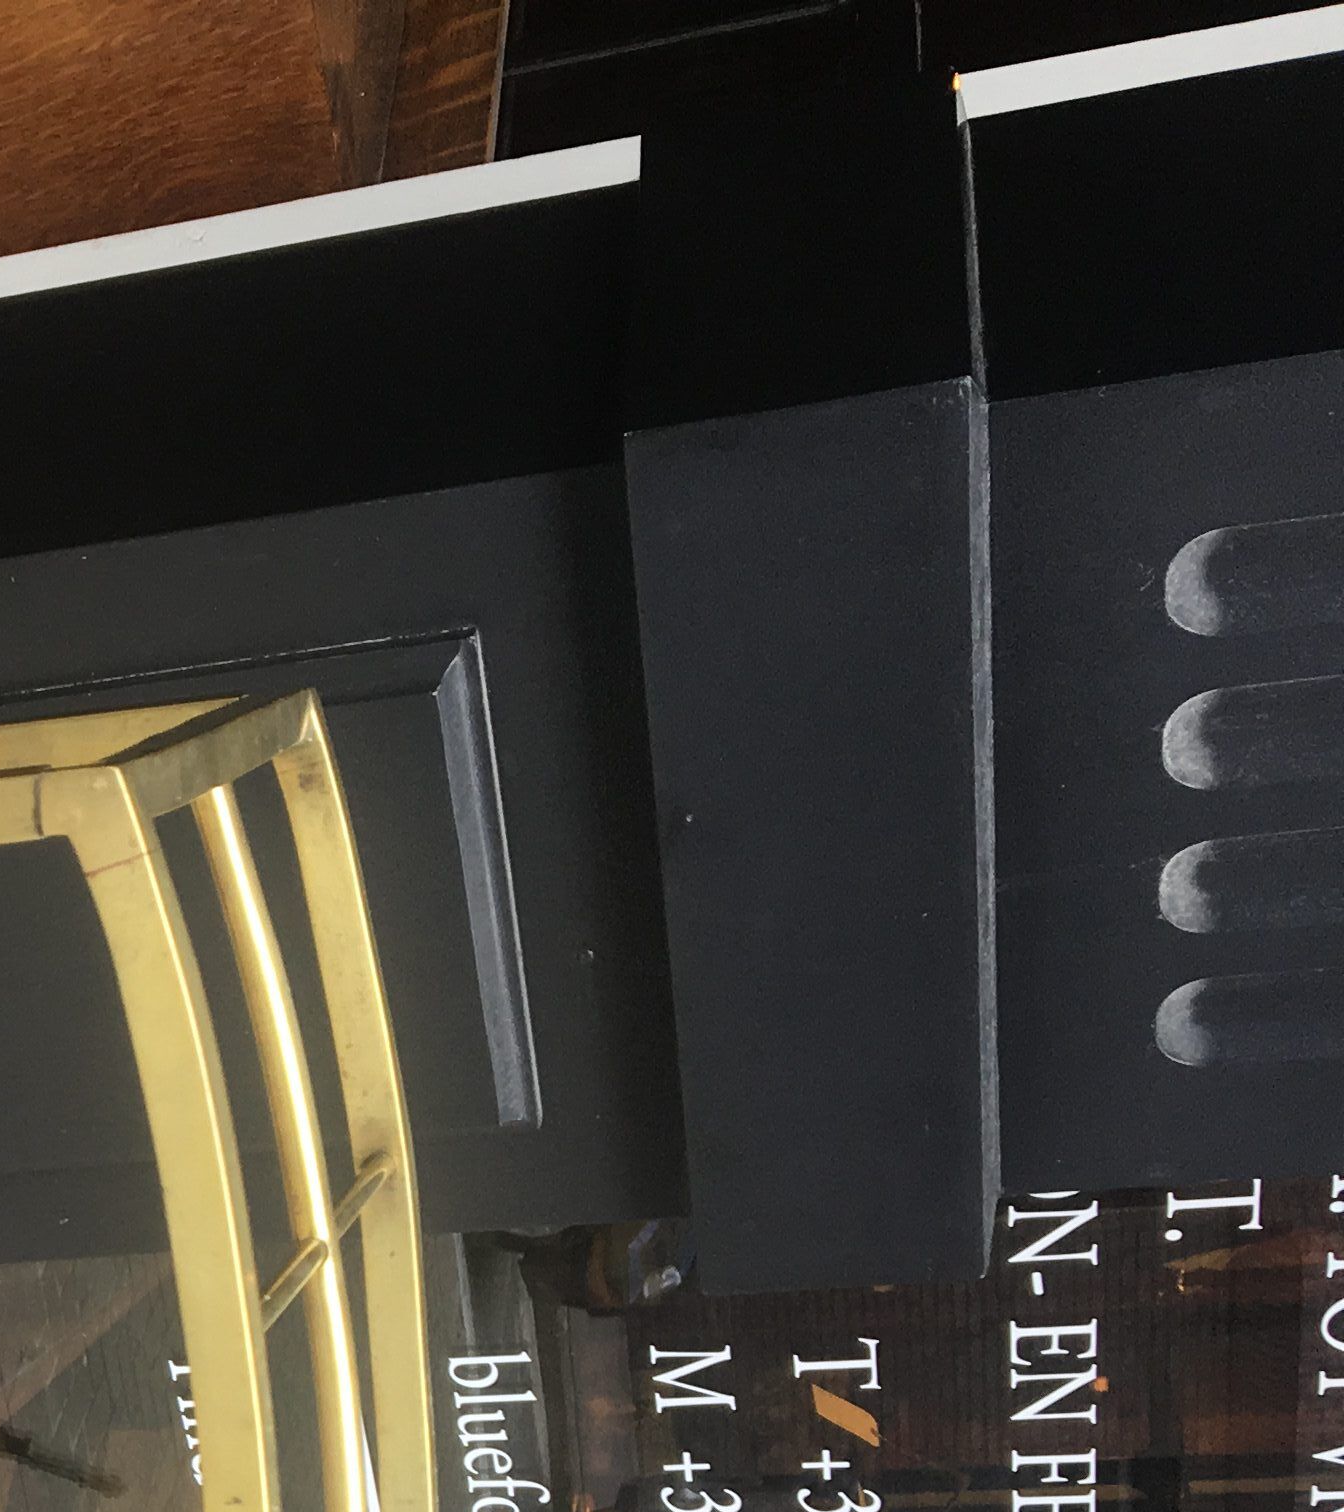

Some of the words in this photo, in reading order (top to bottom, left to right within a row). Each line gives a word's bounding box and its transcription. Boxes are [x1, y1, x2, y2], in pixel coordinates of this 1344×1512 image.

[1006, 1189, 1099, 1297] N-
[648, 1343, 738, 1415] M
[791, 1336, 883, 1391] T
[1008, 1317, 1099, 1426] EN
